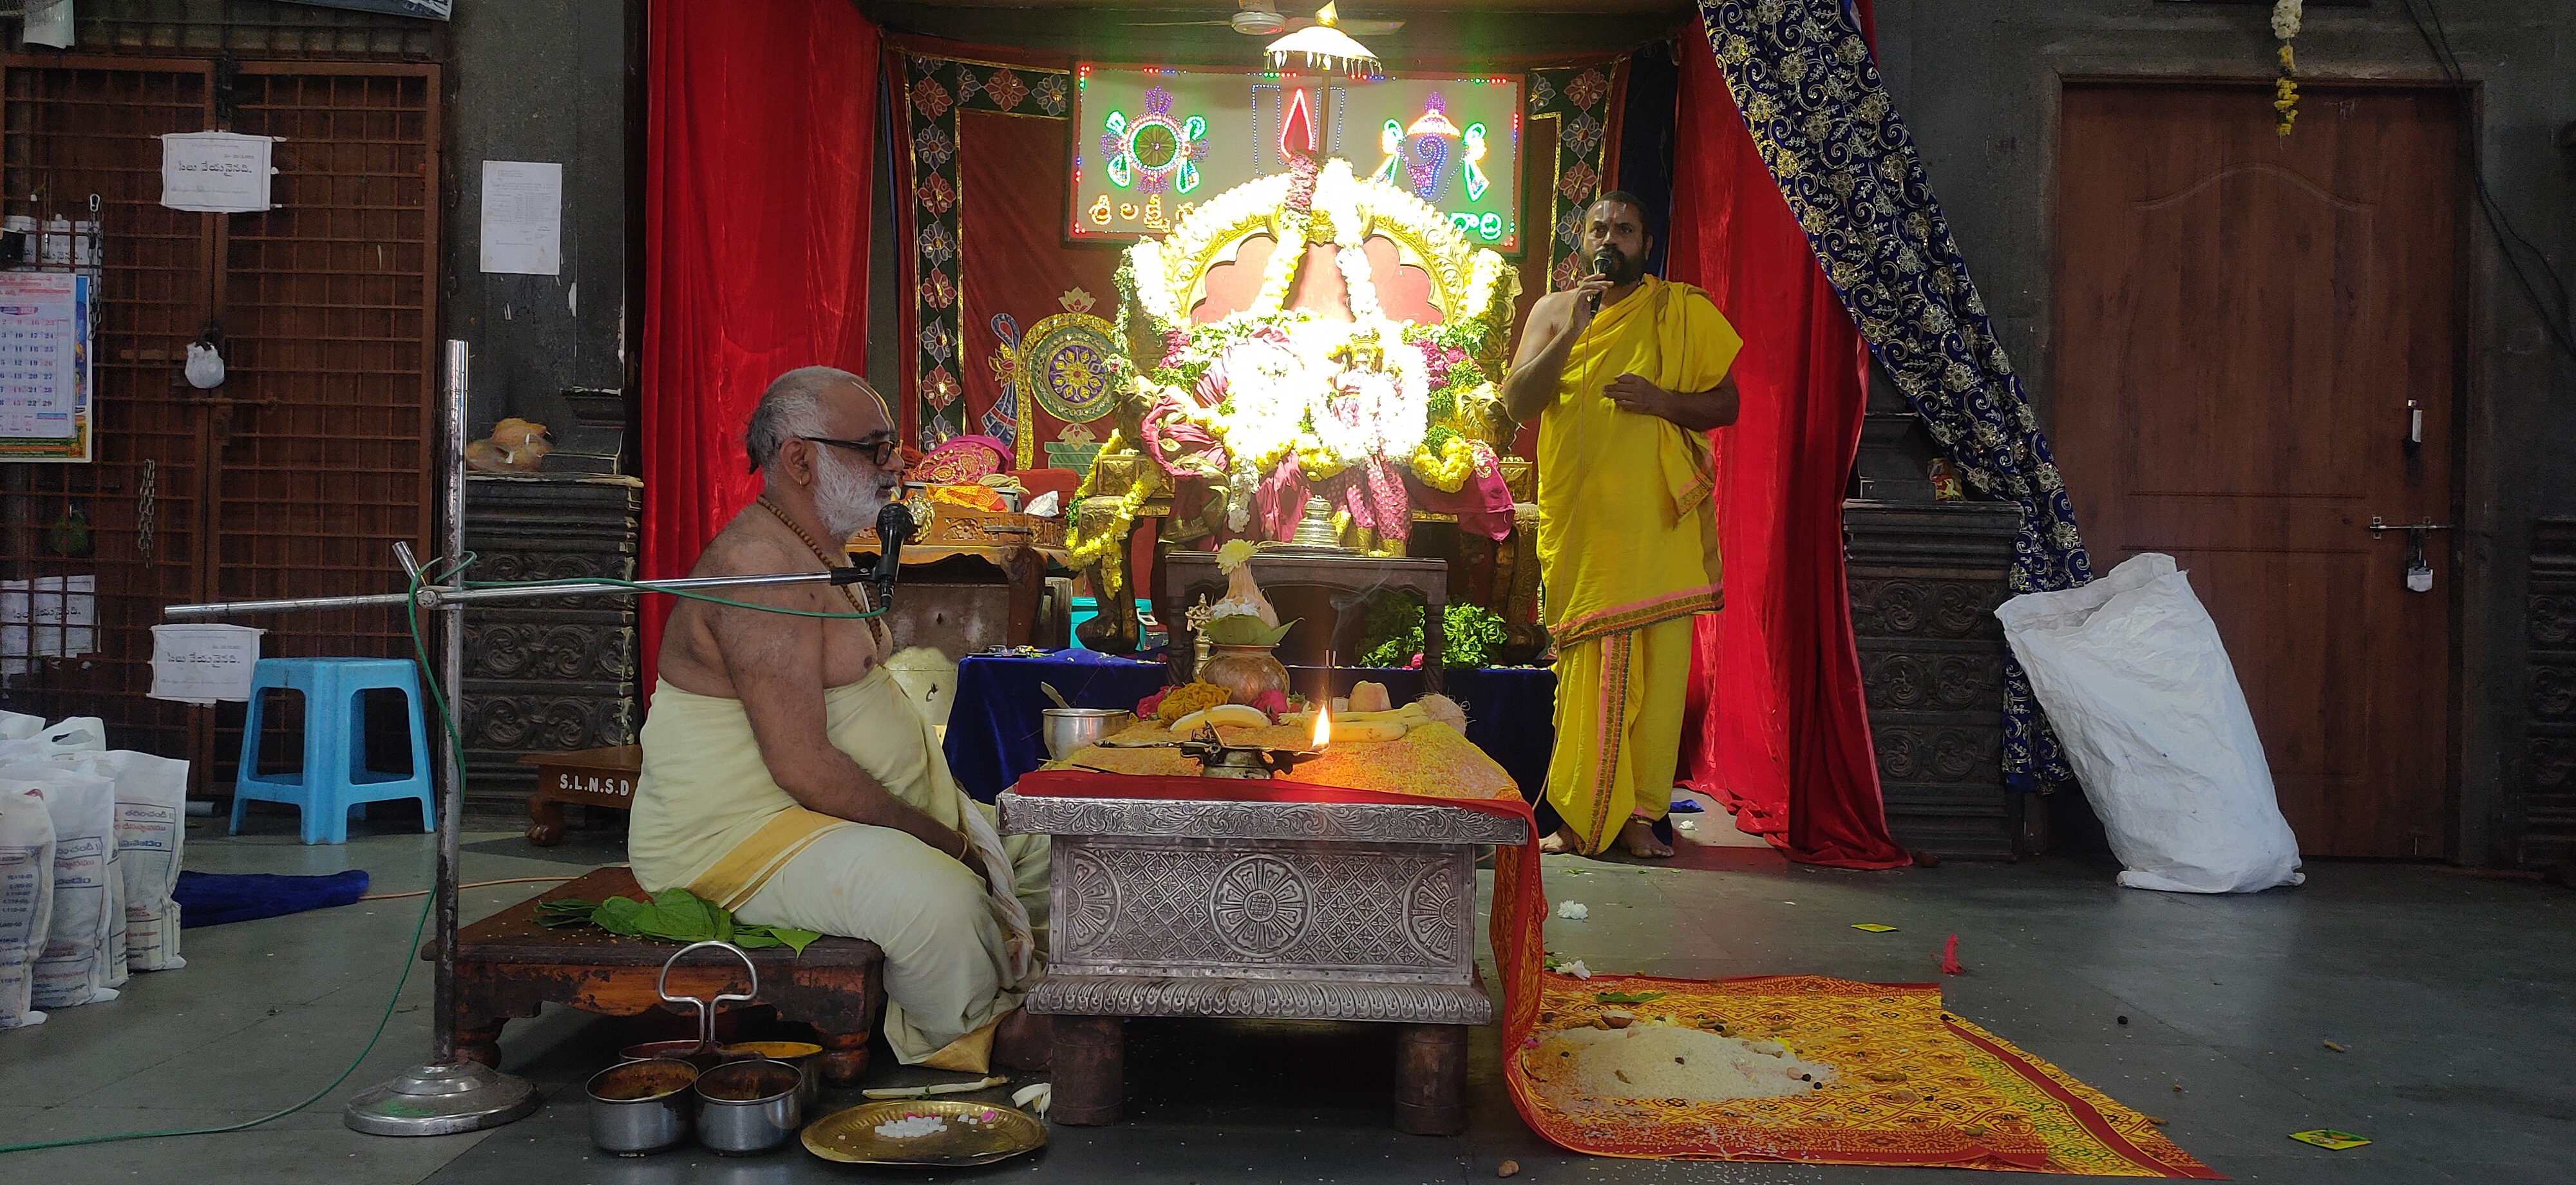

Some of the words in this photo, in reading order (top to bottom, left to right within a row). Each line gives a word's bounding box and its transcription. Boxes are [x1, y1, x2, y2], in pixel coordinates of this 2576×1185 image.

[1088, 194, 1113, 225] శ్రీ
[1447, 211, 1502, 240] దాద్రి
[560, 773, 629, 796] S.L.N.S.D
